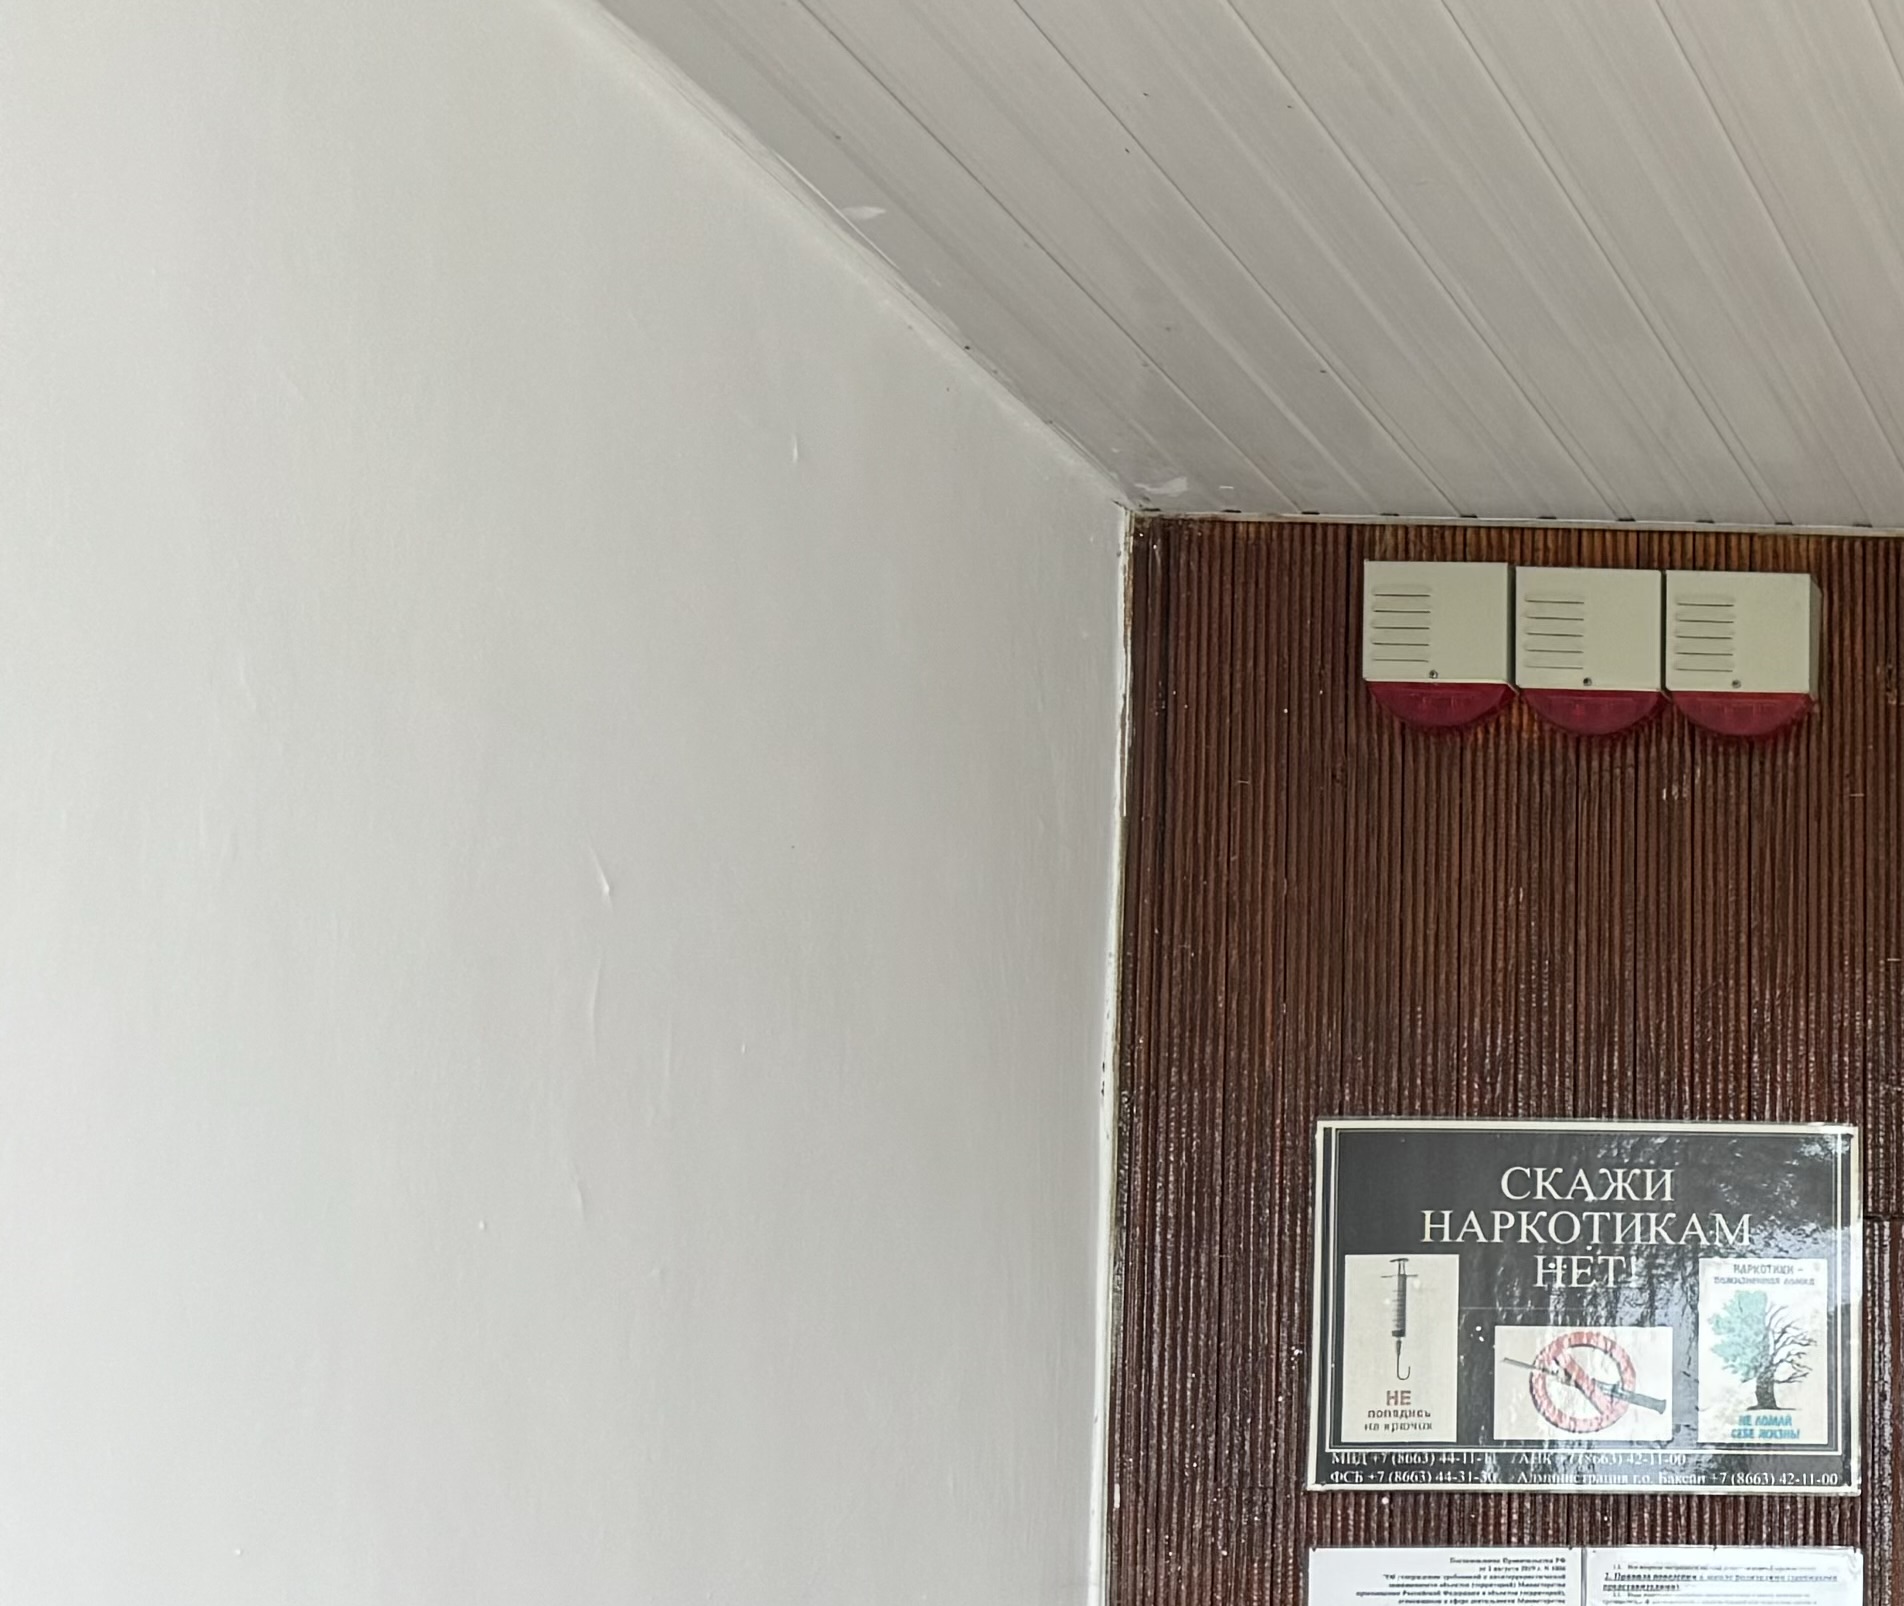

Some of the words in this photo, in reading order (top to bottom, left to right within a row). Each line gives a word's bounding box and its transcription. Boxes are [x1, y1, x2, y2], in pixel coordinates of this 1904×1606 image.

[1500, 1166, 1674, 1202] СКАЖИ
[1420, 1210, 1752, 1246] НАРКОТИКАМ
[1533, 1256, 1638, 1288] НЕТ!
[1386, 1390, 1411, 1406] НЕ
[1368, 1409, 1431, 1419] попадись
[1330, 1470, 1363, 1483] ФСБ
[1368, 1471, 1385, 1483] +7
[1389, 1470, 1432, 1483] (8663)
[1710, 1473, 1726, 1484] +7
[1731, 1472, 1775, 1485] (8663)
[1779, 1473, 1838, 1485] 42-11-00
